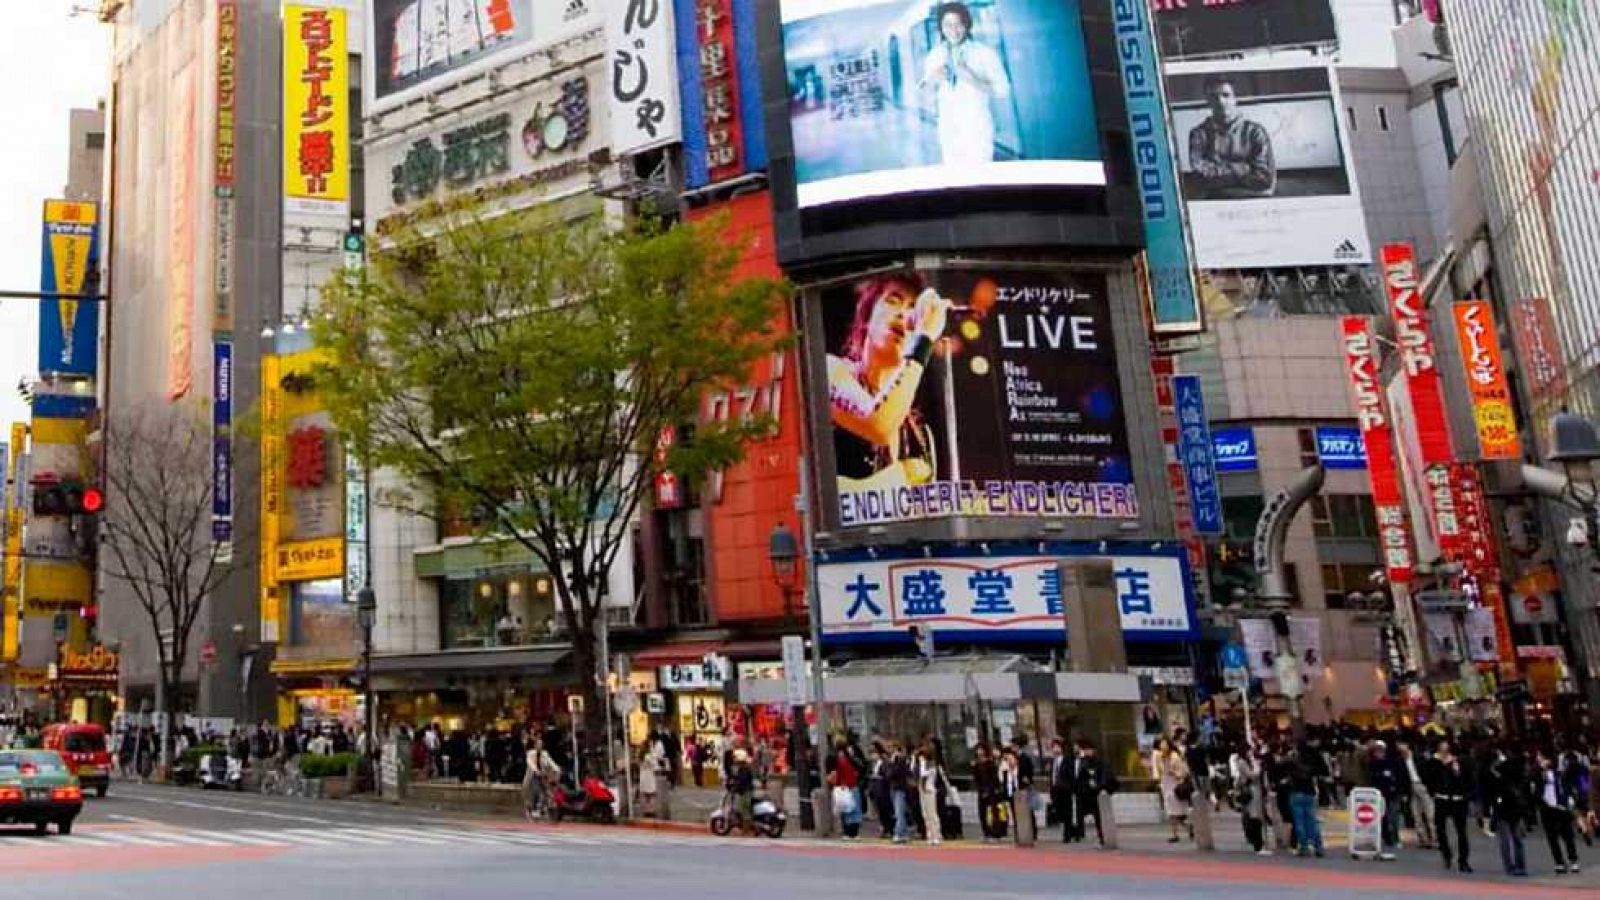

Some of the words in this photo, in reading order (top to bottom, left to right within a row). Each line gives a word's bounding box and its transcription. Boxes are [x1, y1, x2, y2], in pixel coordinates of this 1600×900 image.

[1132, 113, 1166, 219] neon
[996, 286, 1091, 304] エンドリケリー
[998, 314, 1098, 349] LIVE
[1386, 261, 1432, 376] さくらや
[1344, 332, 1384, 431] さくらや
